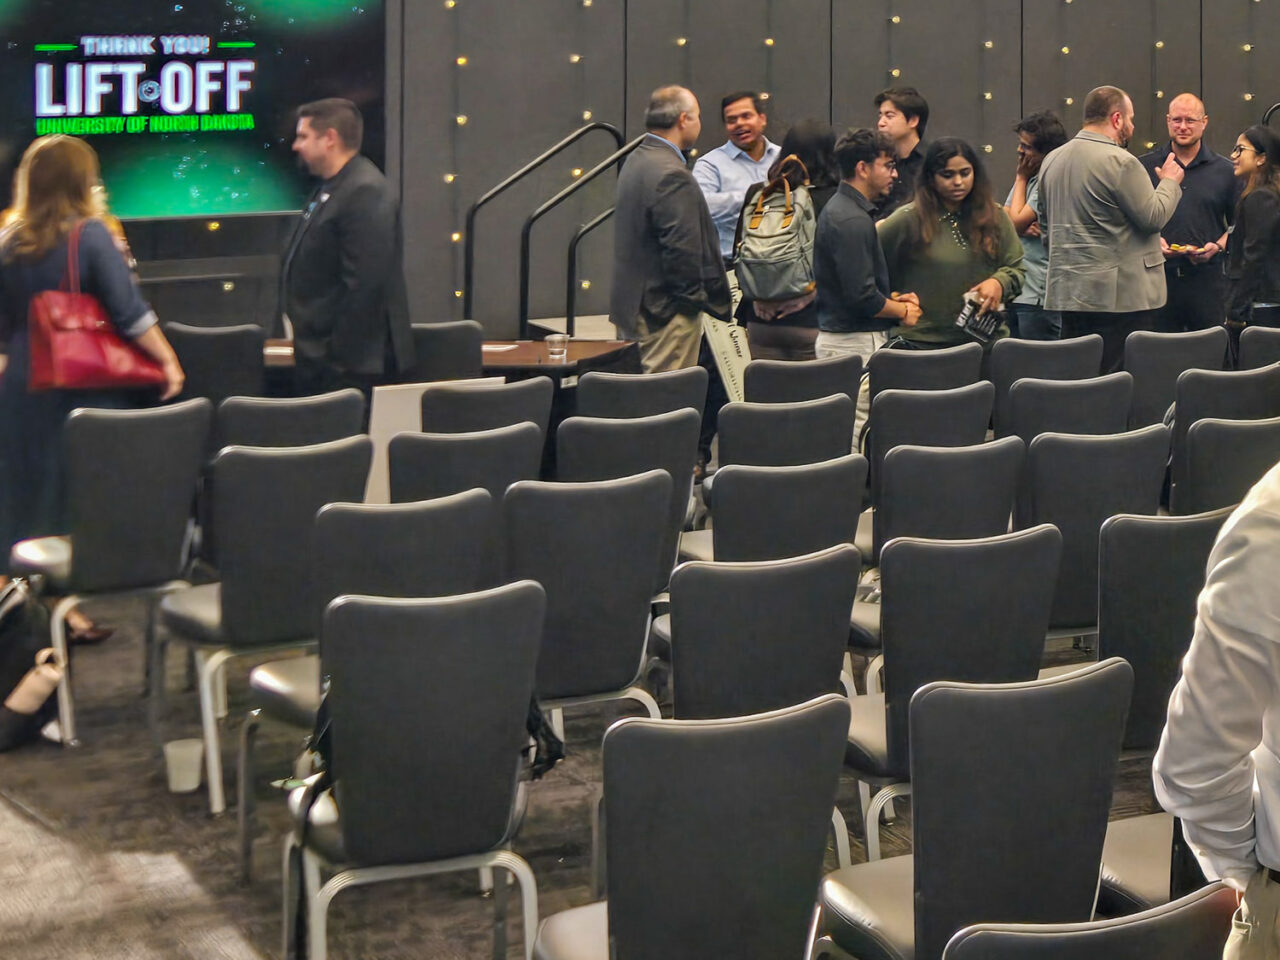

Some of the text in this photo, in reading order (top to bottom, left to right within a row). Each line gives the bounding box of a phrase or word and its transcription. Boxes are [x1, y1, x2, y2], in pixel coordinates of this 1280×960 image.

[81, 35, 210, 56] THANK YOU!
[35, 60, 255, 117] LIFT OFF
[36, 116, 127, 135] UNIVERSITY
